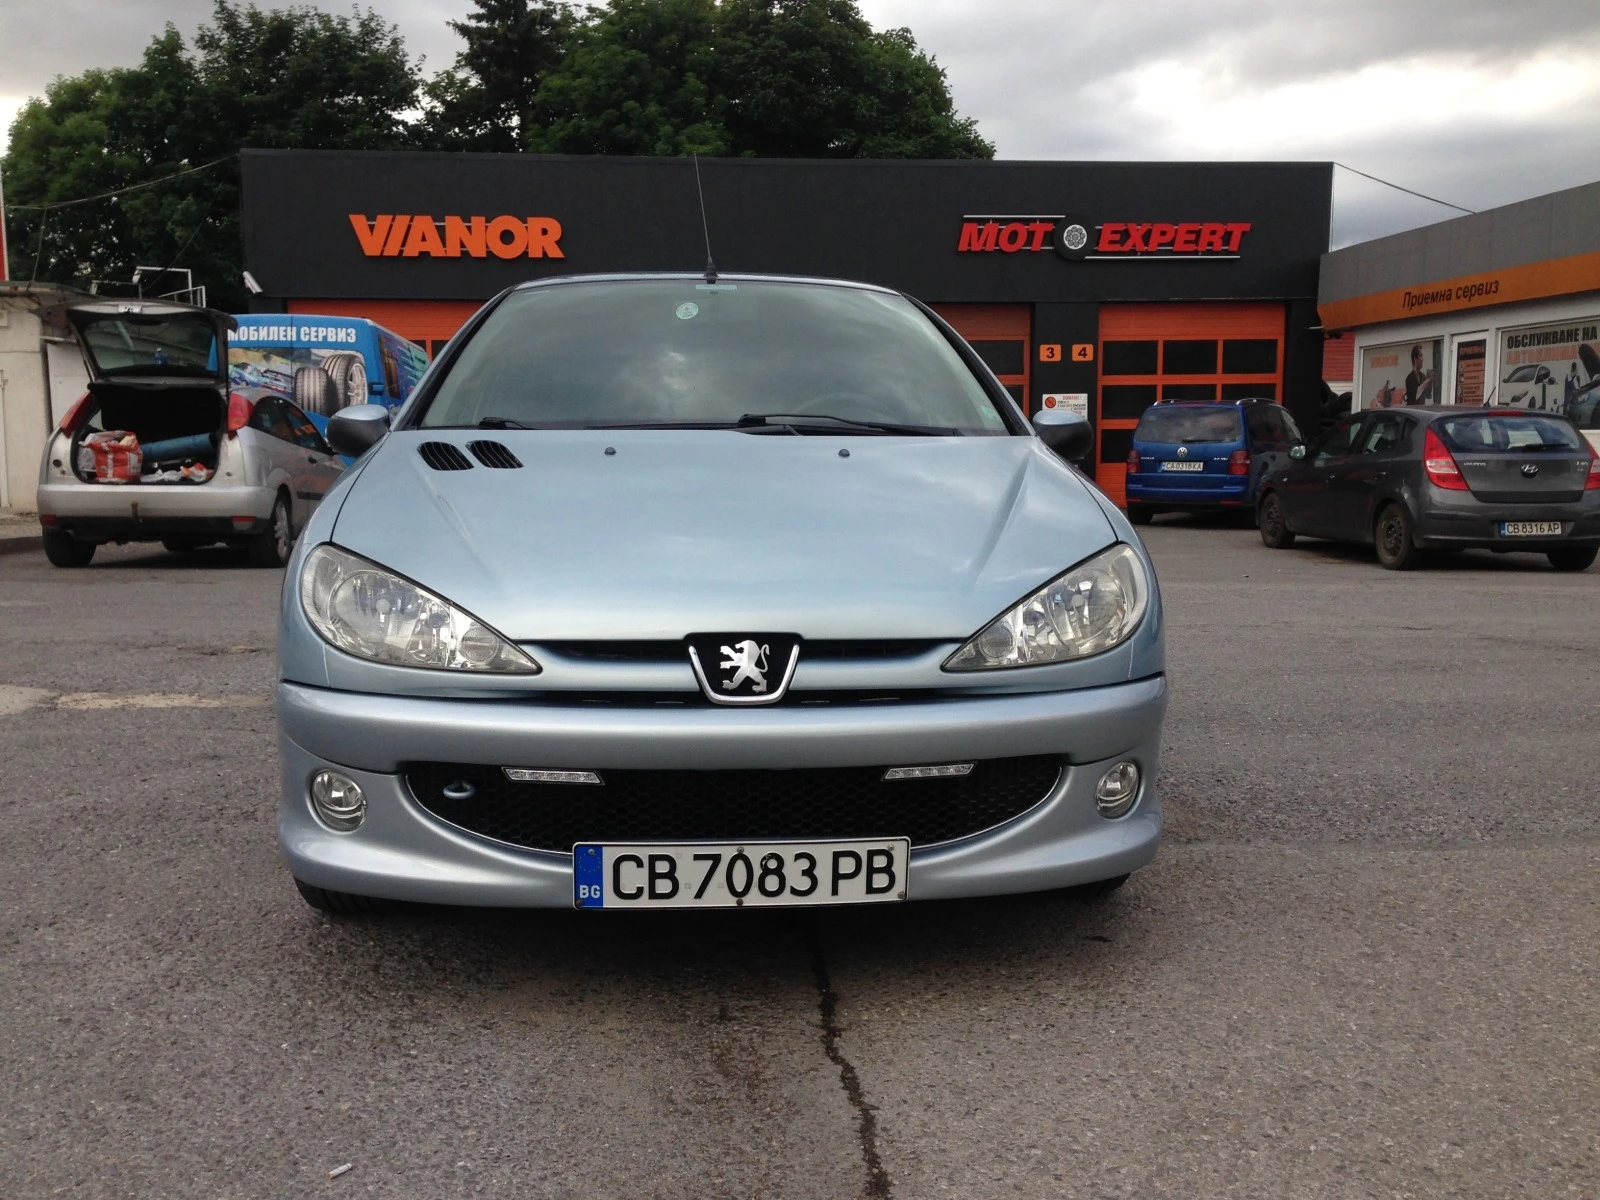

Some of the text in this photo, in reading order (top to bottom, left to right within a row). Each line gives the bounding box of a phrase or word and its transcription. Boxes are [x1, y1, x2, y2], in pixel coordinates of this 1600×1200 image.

[349, 214, 565, 259] VIANOR
[1097, 223, 1251, 252] EXPERT
[1403, 280, 1499, 308] Приемна сервиз
[300, 327, 356, 342] СЕРВИЗ
[1507, 326, 1597, 349] ОБСЛУЖВАНЕ НА
[1046, 347, 1055, 359] 3
[1078, 347, 1087, 358] 4
[1507, 523, 1560, 534] CB 8316 AP
[612, 848, 896, 901] CB 7083 PB
[579, 885, 600, 899] BG
